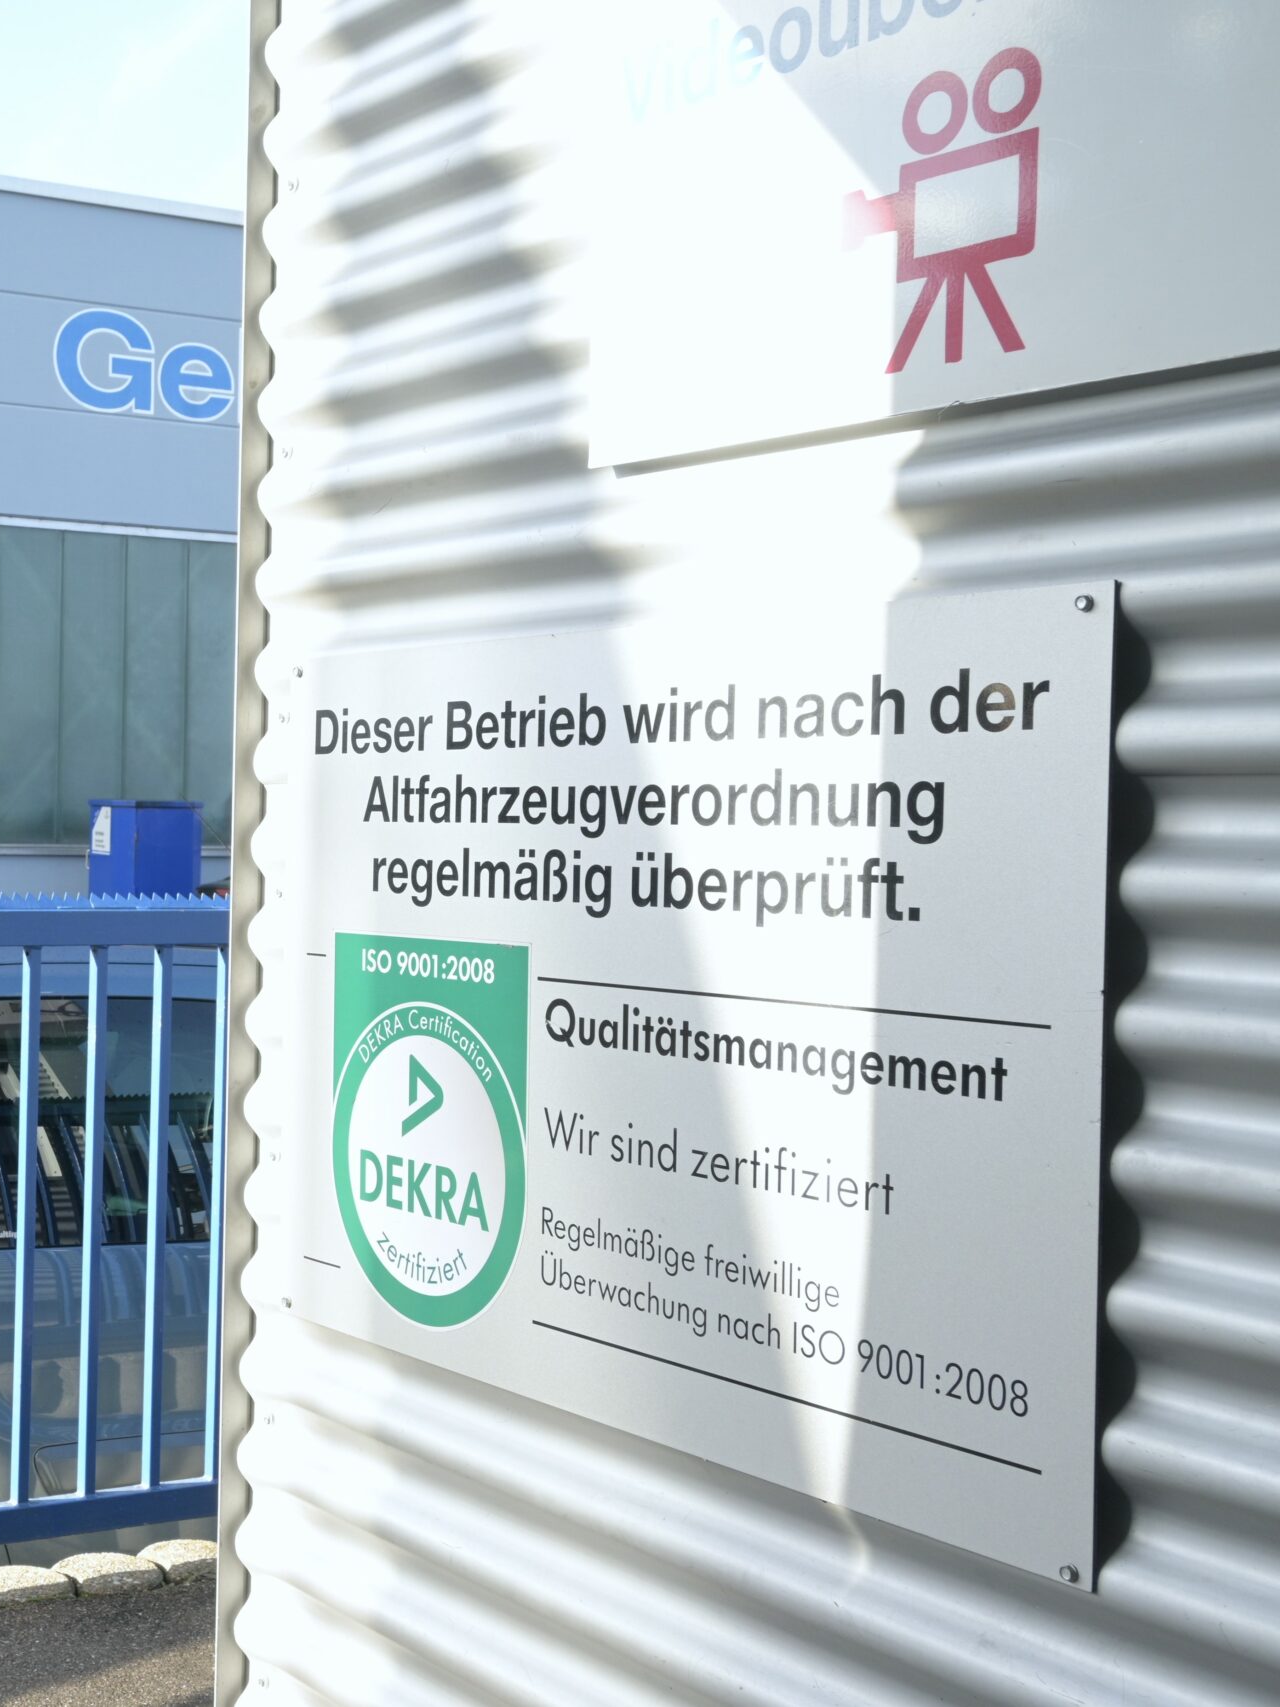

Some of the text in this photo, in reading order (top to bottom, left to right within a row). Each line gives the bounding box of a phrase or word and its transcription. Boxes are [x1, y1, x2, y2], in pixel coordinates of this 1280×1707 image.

[315, 668, 1050, 755] Dieser Betrieb wird nach der
[363, 769, 945, 844] Altfahrzeugverordnung
[372, 848, 920, 928] regelmäßig überprüft.
[361, 948, 495, 984] ISO 9001:2008
[358, 1009, 493, 1082] DEKRA Certification
[545, 998, 1008, 1101] Qualitätsmanagement
[360, 1149, 489, 1232] DEKRA
[544, 1106, 894, 1215] Wir sind zertifiziert
[376, 1231, 467, 1285] zertifiziert
[541, 1206, 840, 1313] Regelmäßige freiwillige
[540, 1250, 1029, 1418] Überwachung nach ISO 9001:2008
